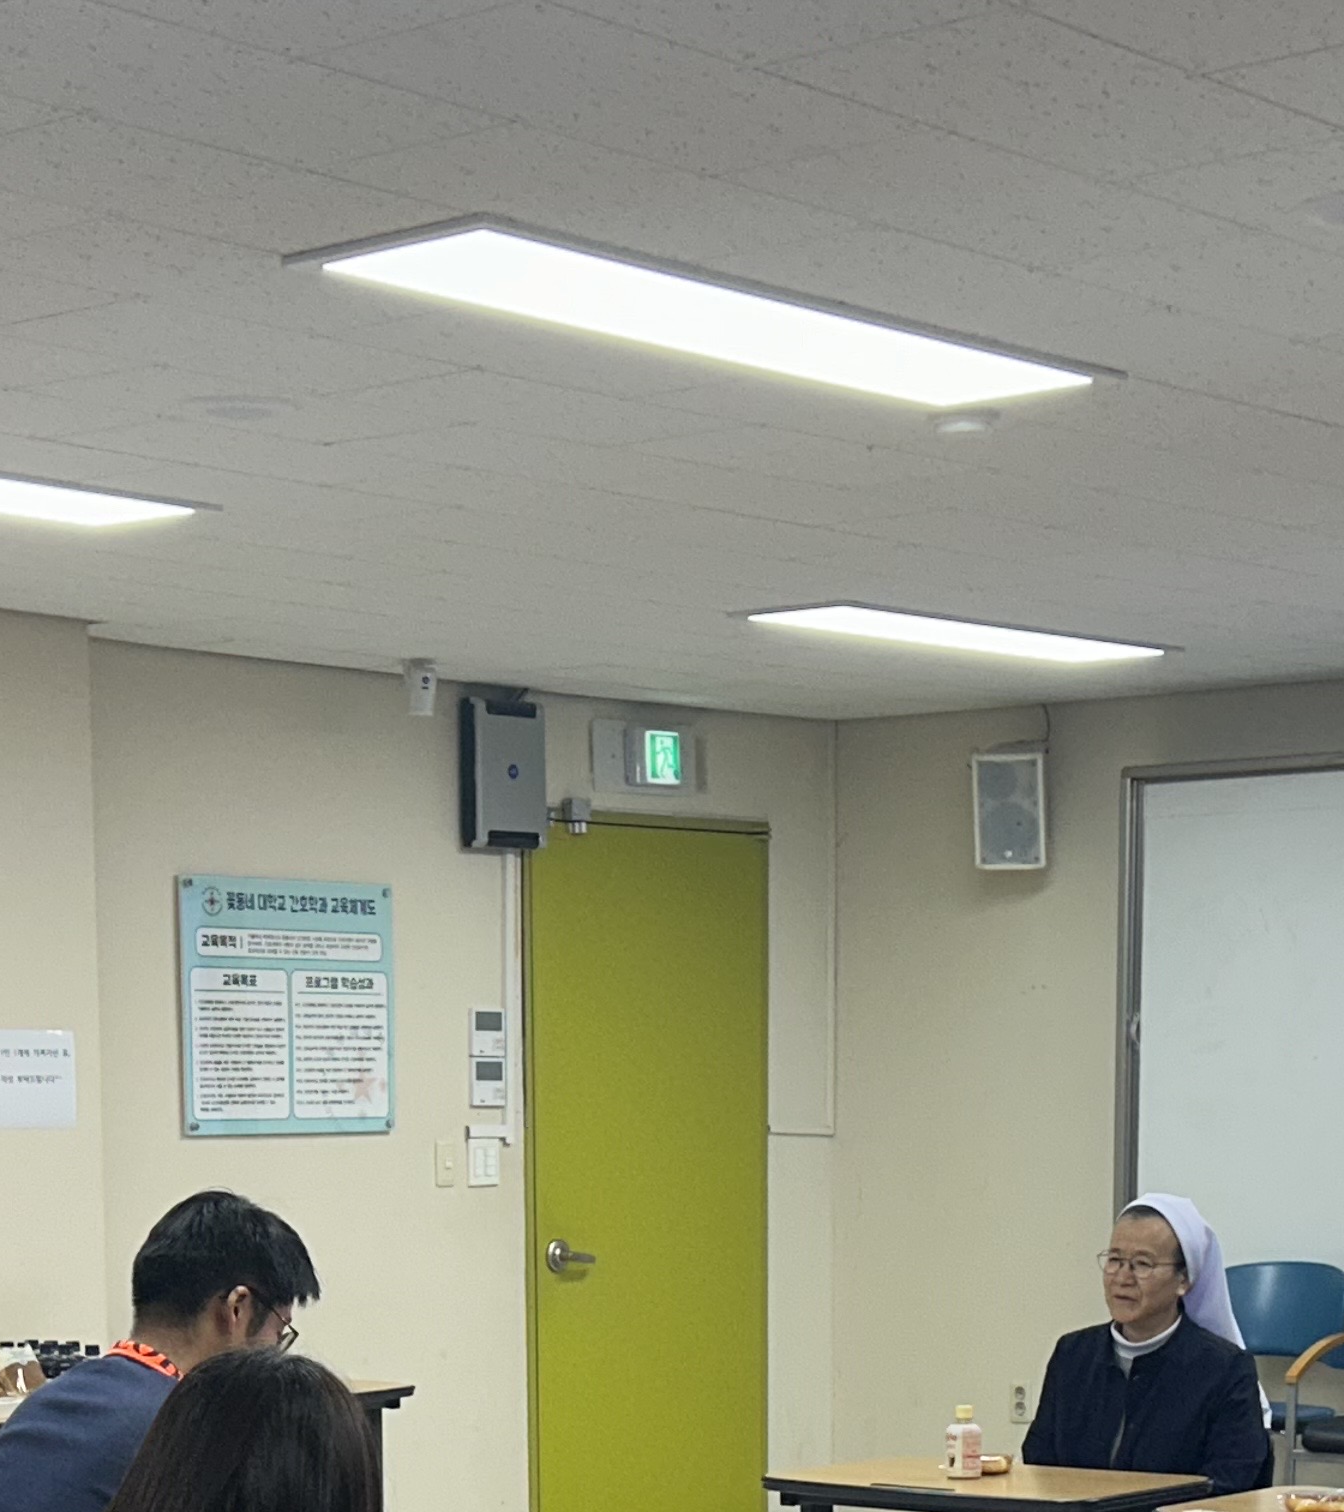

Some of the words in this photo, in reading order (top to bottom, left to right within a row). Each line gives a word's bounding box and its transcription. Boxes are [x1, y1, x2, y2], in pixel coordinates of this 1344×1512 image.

[226, 891, 256, 911] 꽃동네
[257, 893, 287, 912] 대학교
[289, 894, 328, 914] 간호학과
[305, 975, 339, 990] 프로그램
